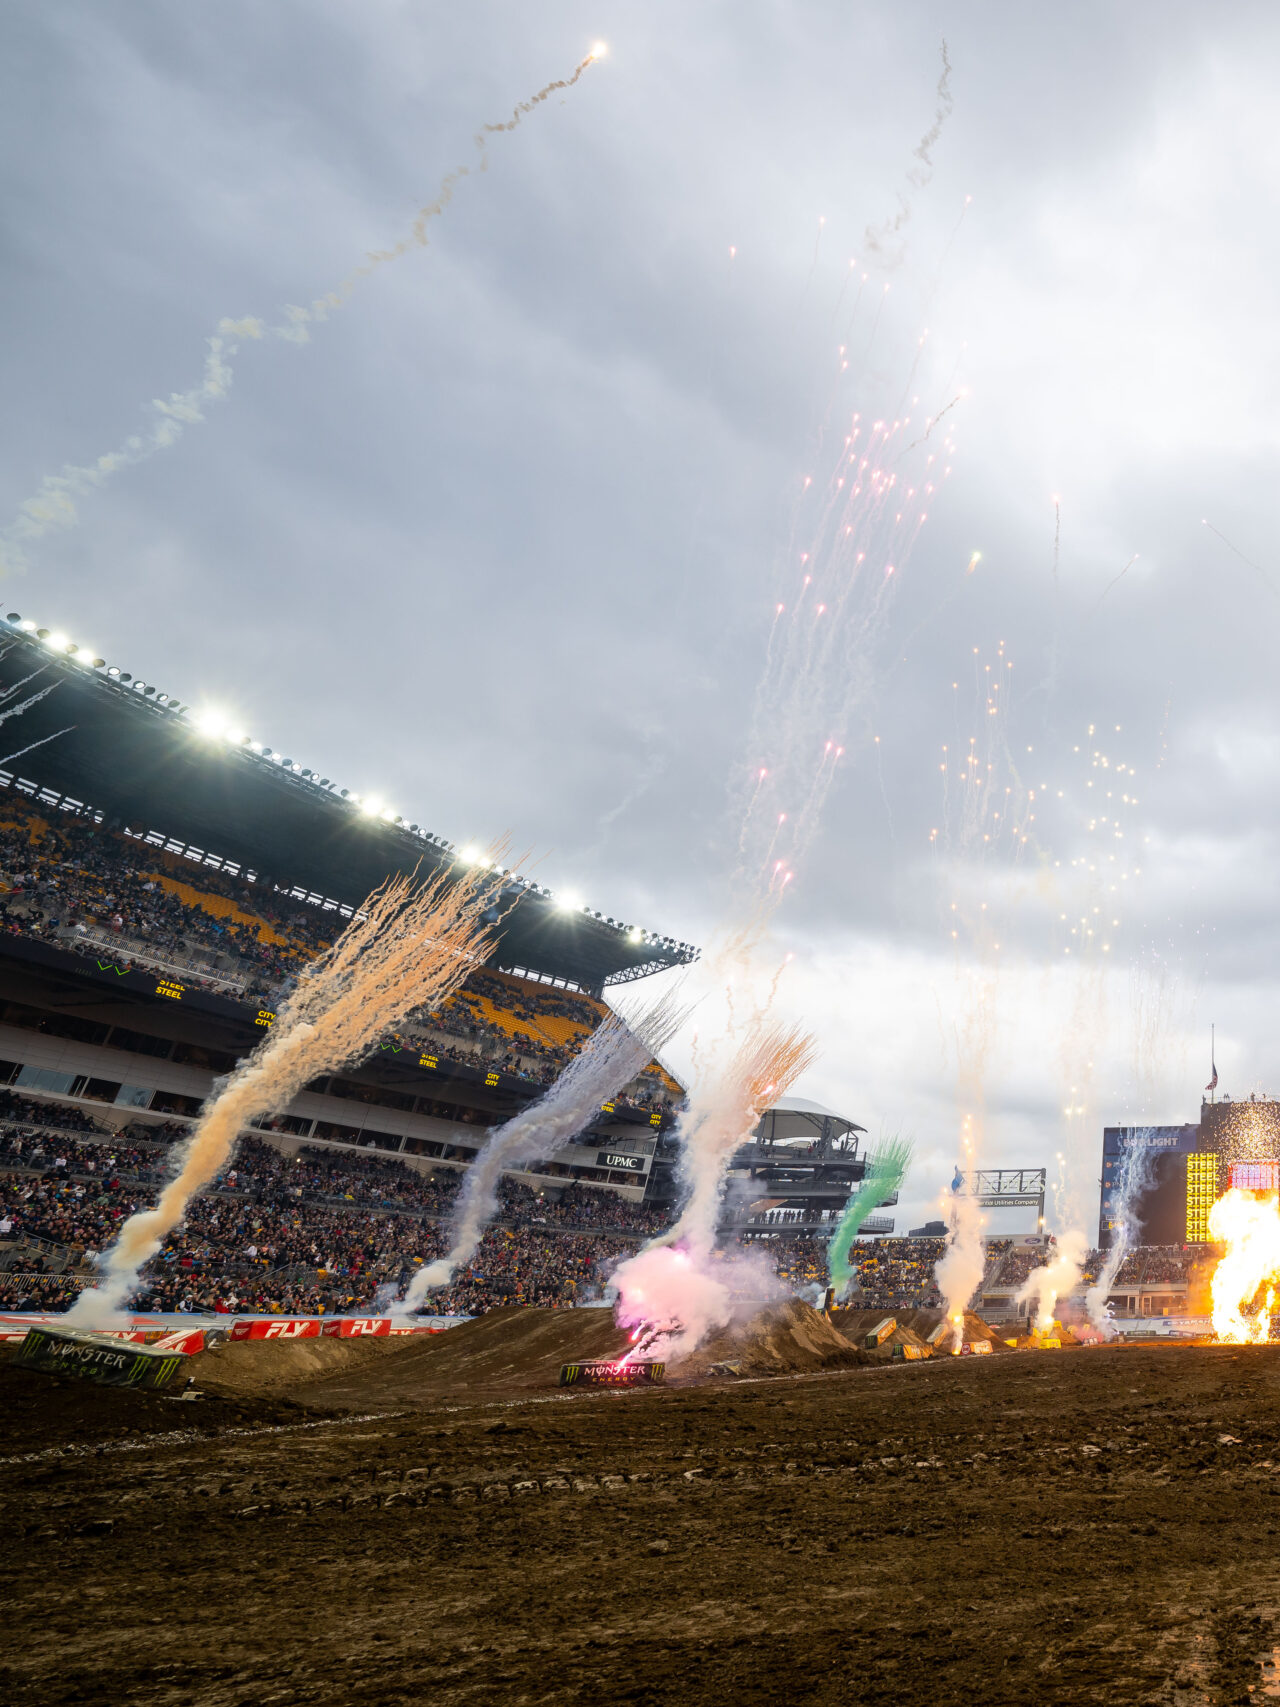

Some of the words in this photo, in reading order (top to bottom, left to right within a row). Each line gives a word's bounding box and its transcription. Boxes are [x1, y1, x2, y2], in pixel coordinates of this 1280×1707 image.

[155, 986, 182, 1000] STEEL
[258, 1010, 276, 1020] CITY
[255, 1018, 273, 1027] CITY
[419, 1058, 437, 1069] STEEL
[487, 1072, 500, 1081] CITY
[485, 1079, 498, 1087] CITY
[1147, 1137, 1178, 1147] LIGHT
[606, 1155, 638, 1168] UPMC
[264, 1322, 310, 1338] FLY
[350, 1320, 382, 1334] FLY
[48, 1340, 128, 1369] MONSTER
[584, 1365, 646, 1377] MONSTER
